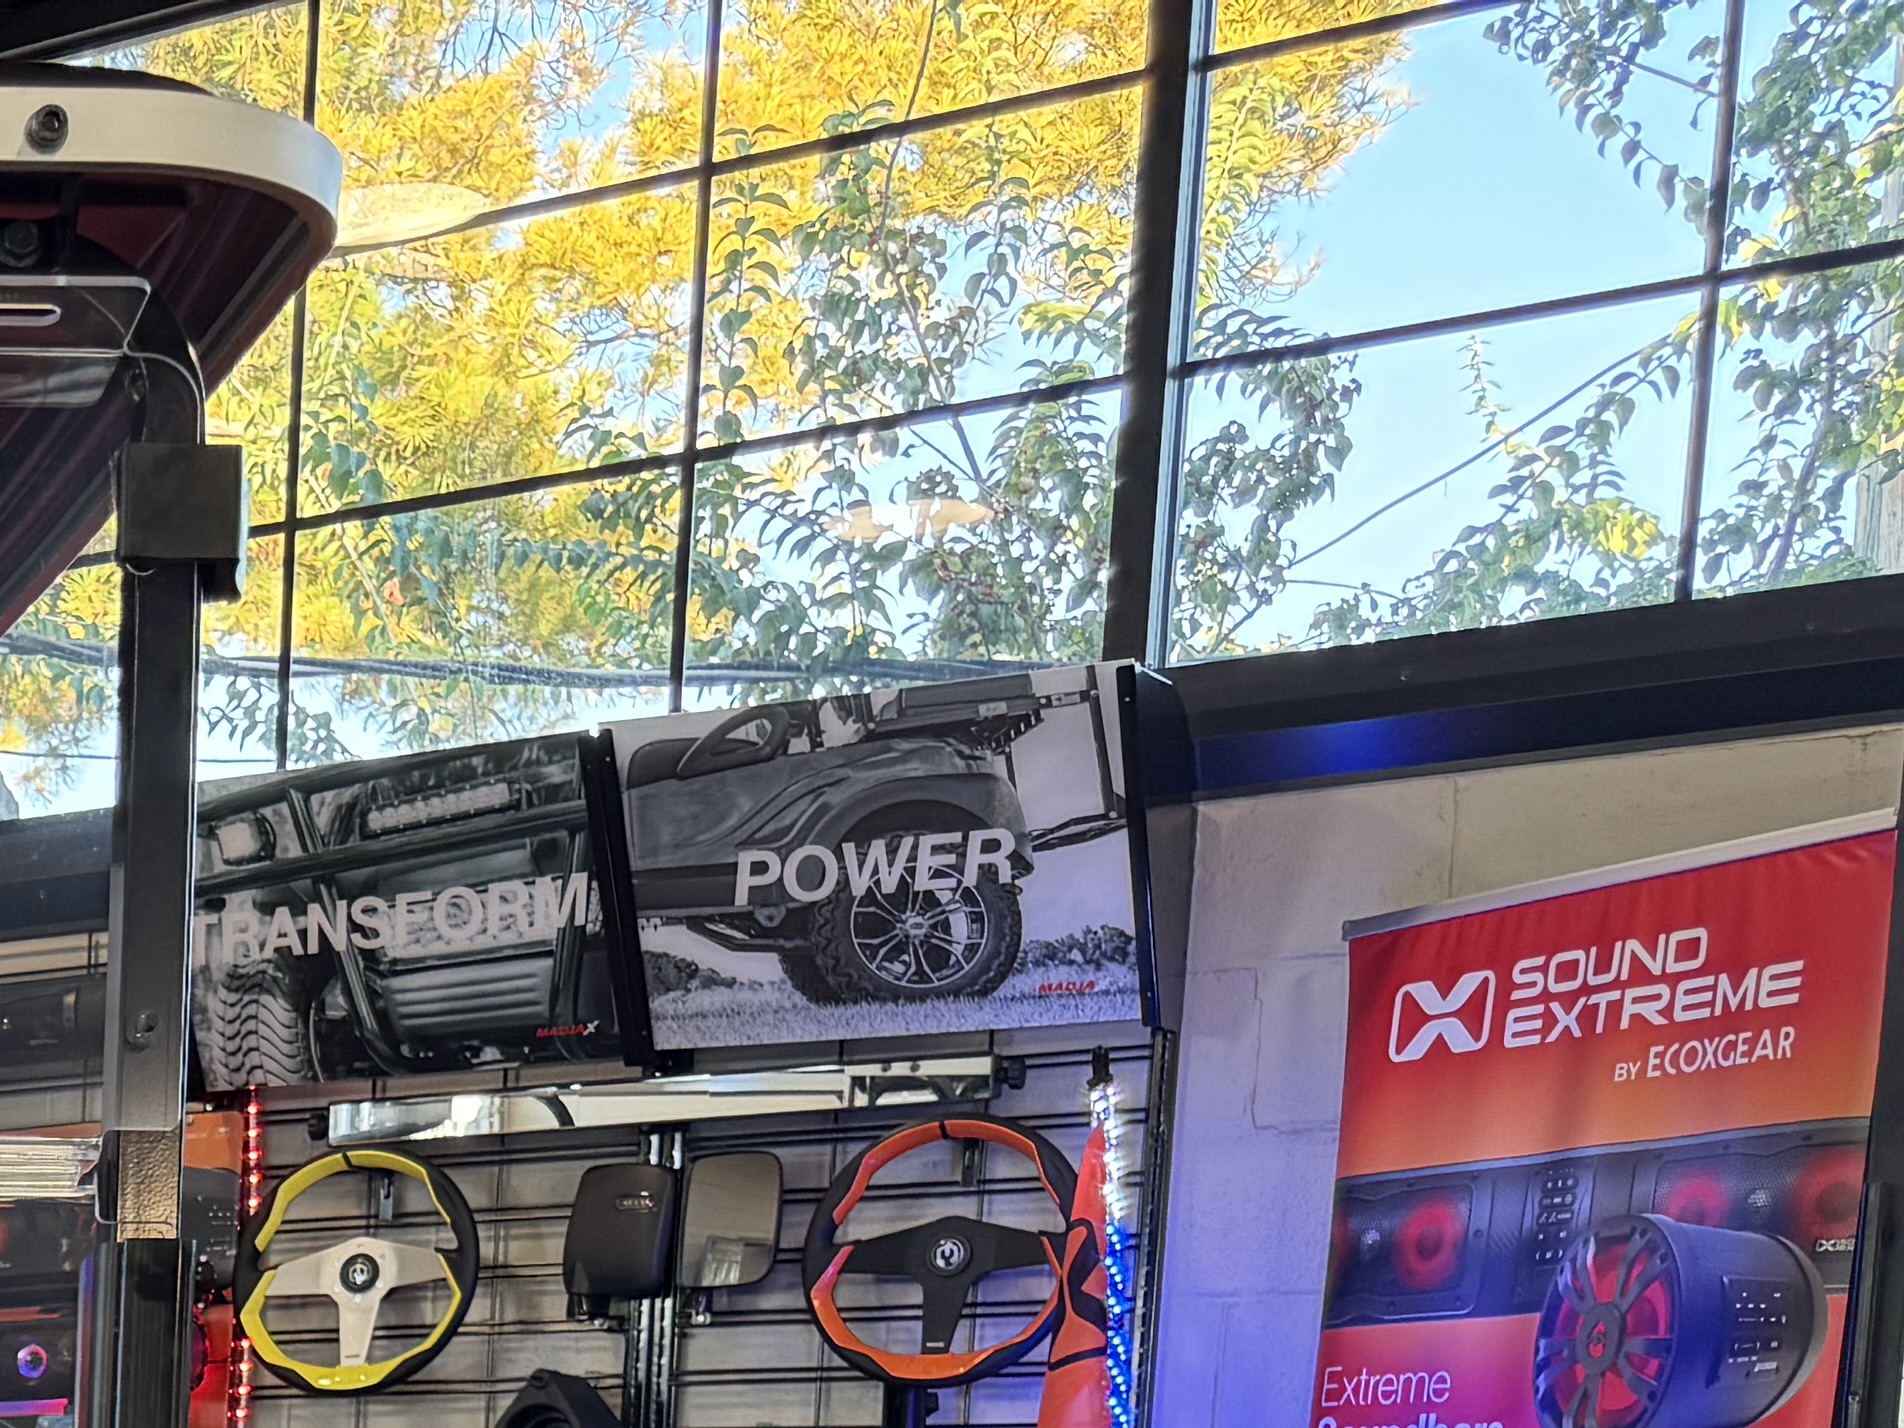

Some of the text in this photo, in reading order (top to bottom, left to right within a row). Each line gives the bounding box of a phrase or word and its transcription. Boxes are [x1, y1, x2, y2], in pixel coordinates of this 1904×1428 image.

[733, 827, 1019, 907] POWER
[191, 871, 590, 966] TRANSFORM
[1510, 927, 1708, 1000] SOUND
[1503, 960, 1805, 1048] EXTREME
[1614, 1026, 1796, 1082] BY ECOXGEAR
[1321, 1366, 1452, 1407] Extreme
